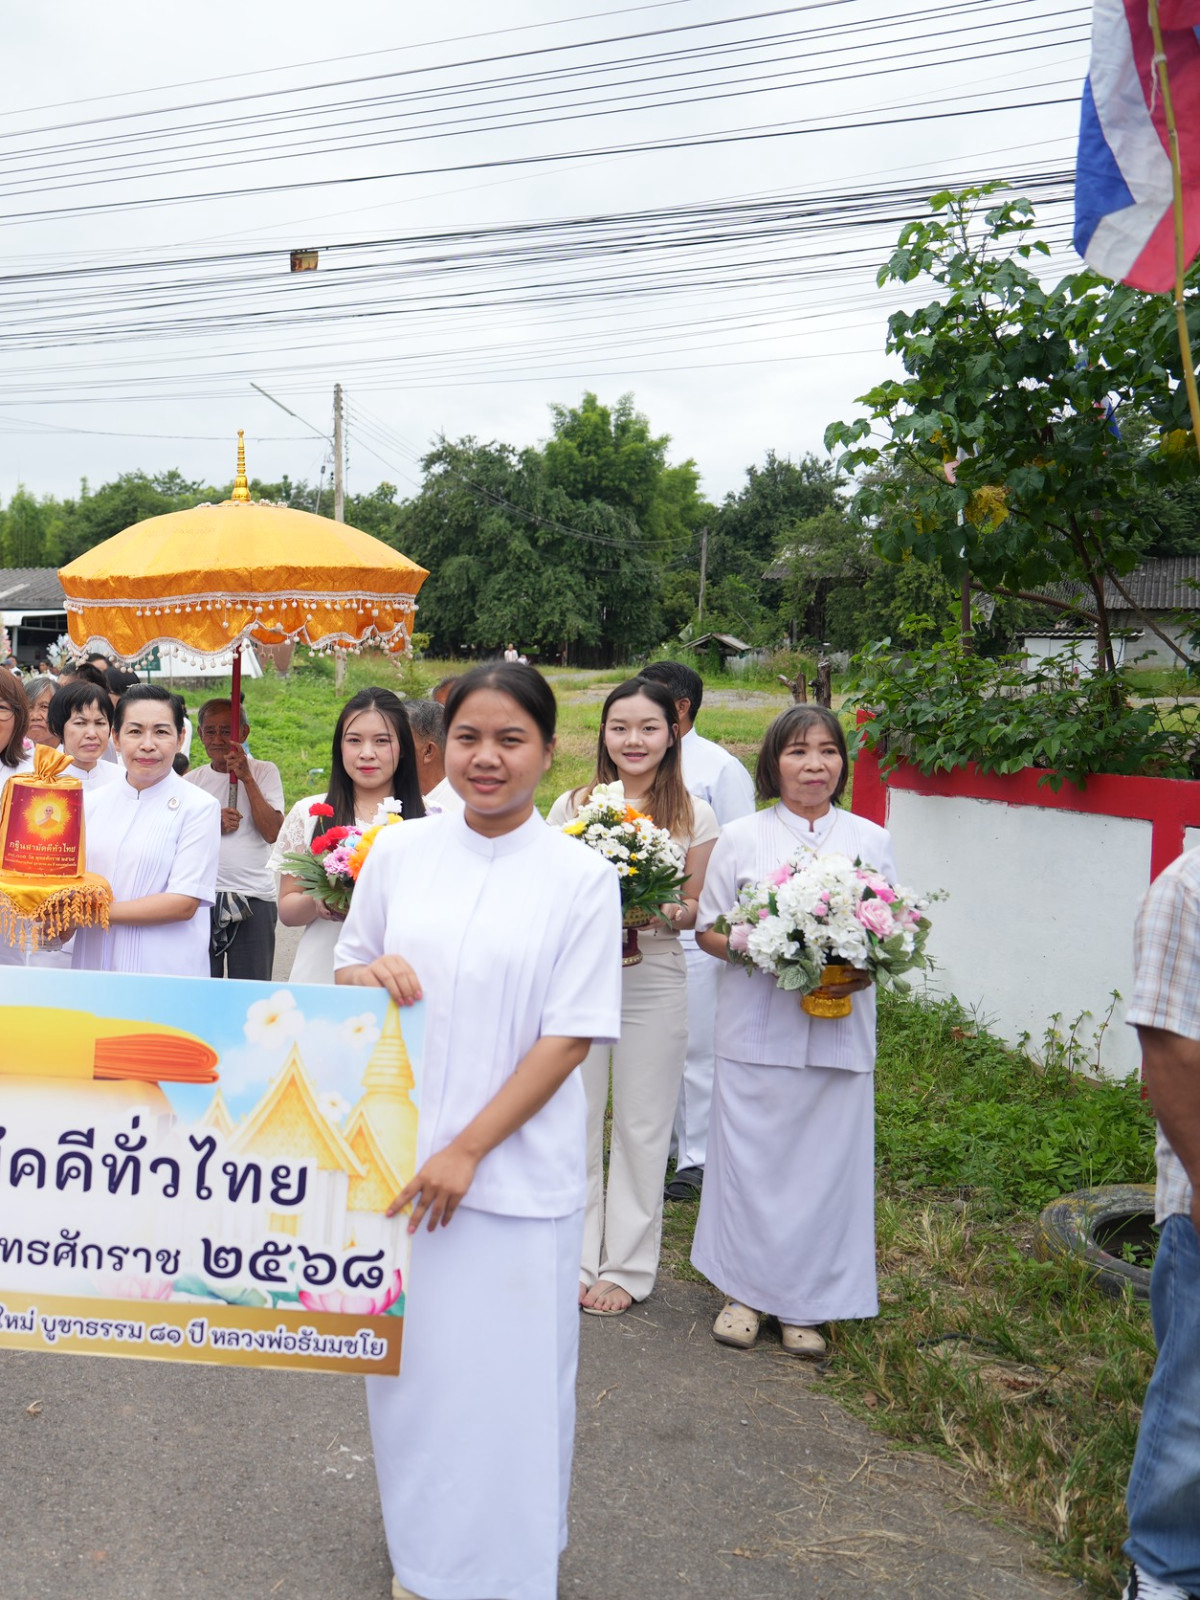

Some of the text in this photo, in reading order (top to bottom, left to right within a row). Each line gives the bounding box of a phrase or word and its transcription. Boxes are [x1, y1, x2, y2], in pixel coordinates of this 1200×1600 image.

[201, 1237, 385, 1289] ๒๕๖๘
[42, 1316, 143, 1341] บูชาธรรม
[149, 1326, 182, 1343] ๘๑
[189, 1321, 206, 1344] ปี
